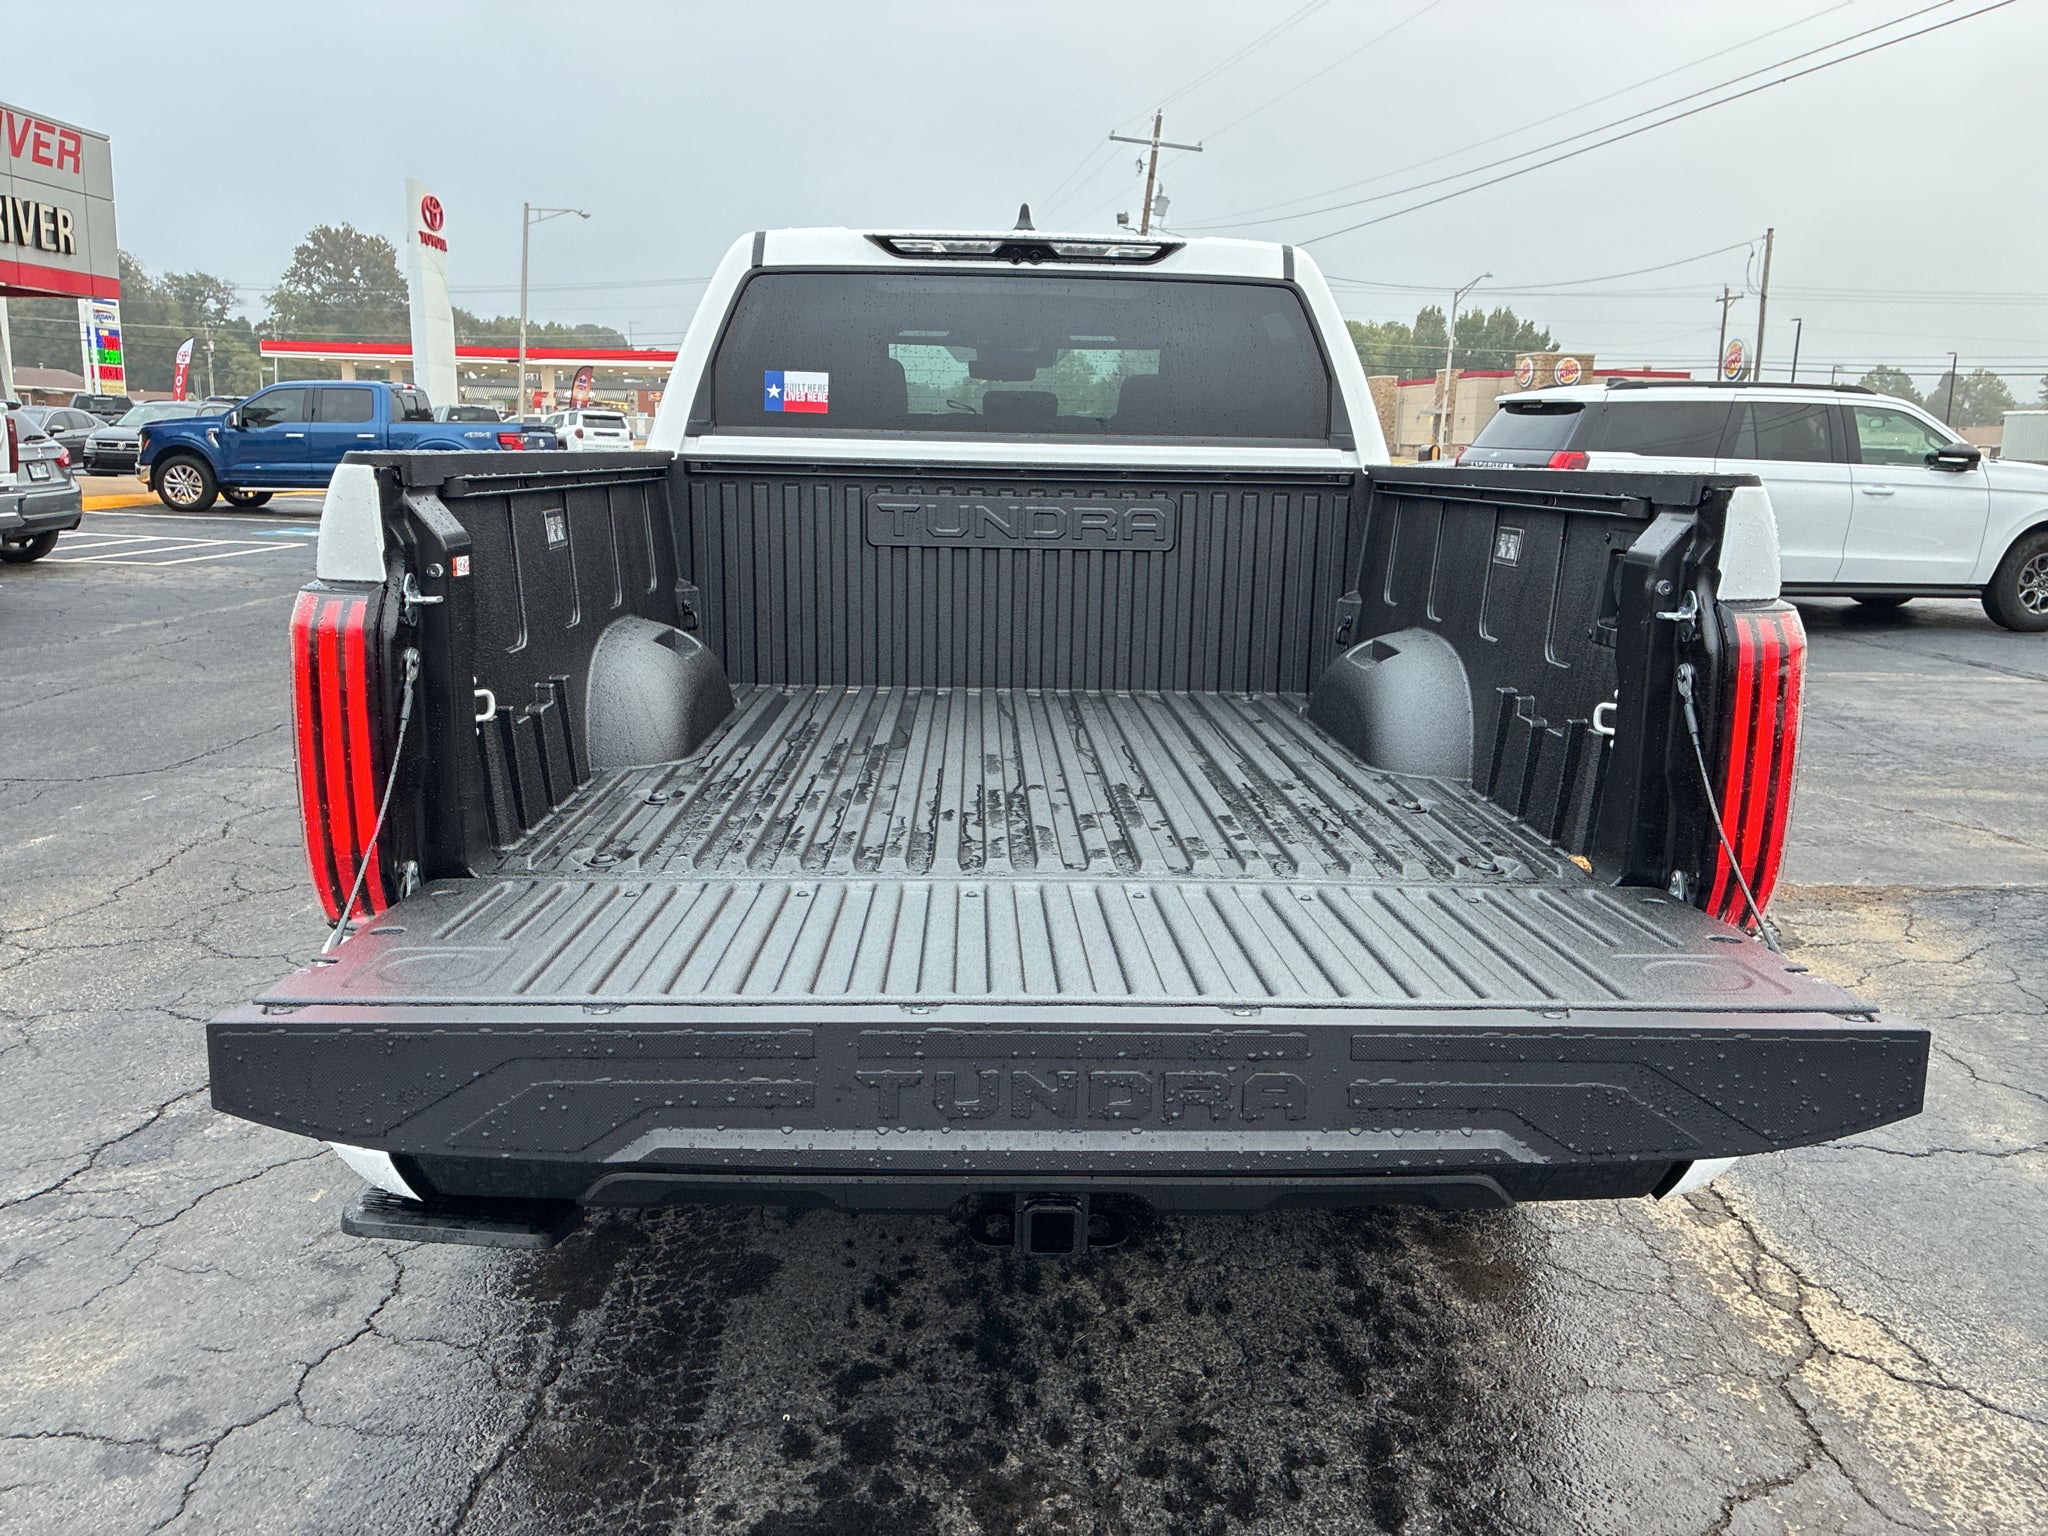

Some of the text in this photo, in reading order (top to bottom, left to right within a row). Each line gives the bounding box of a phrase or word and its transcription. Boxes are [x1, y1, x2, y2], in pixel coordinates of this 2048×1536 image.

[175, 364, 186, 402] TOY
[784, 383, 828, 394] BUILT HERE
[784, 391, 829, 403] LIVES HERE
[877, 503, 1166, 541] TUNDRA
[855, 1070, 1306, 1121] TUNDRA
